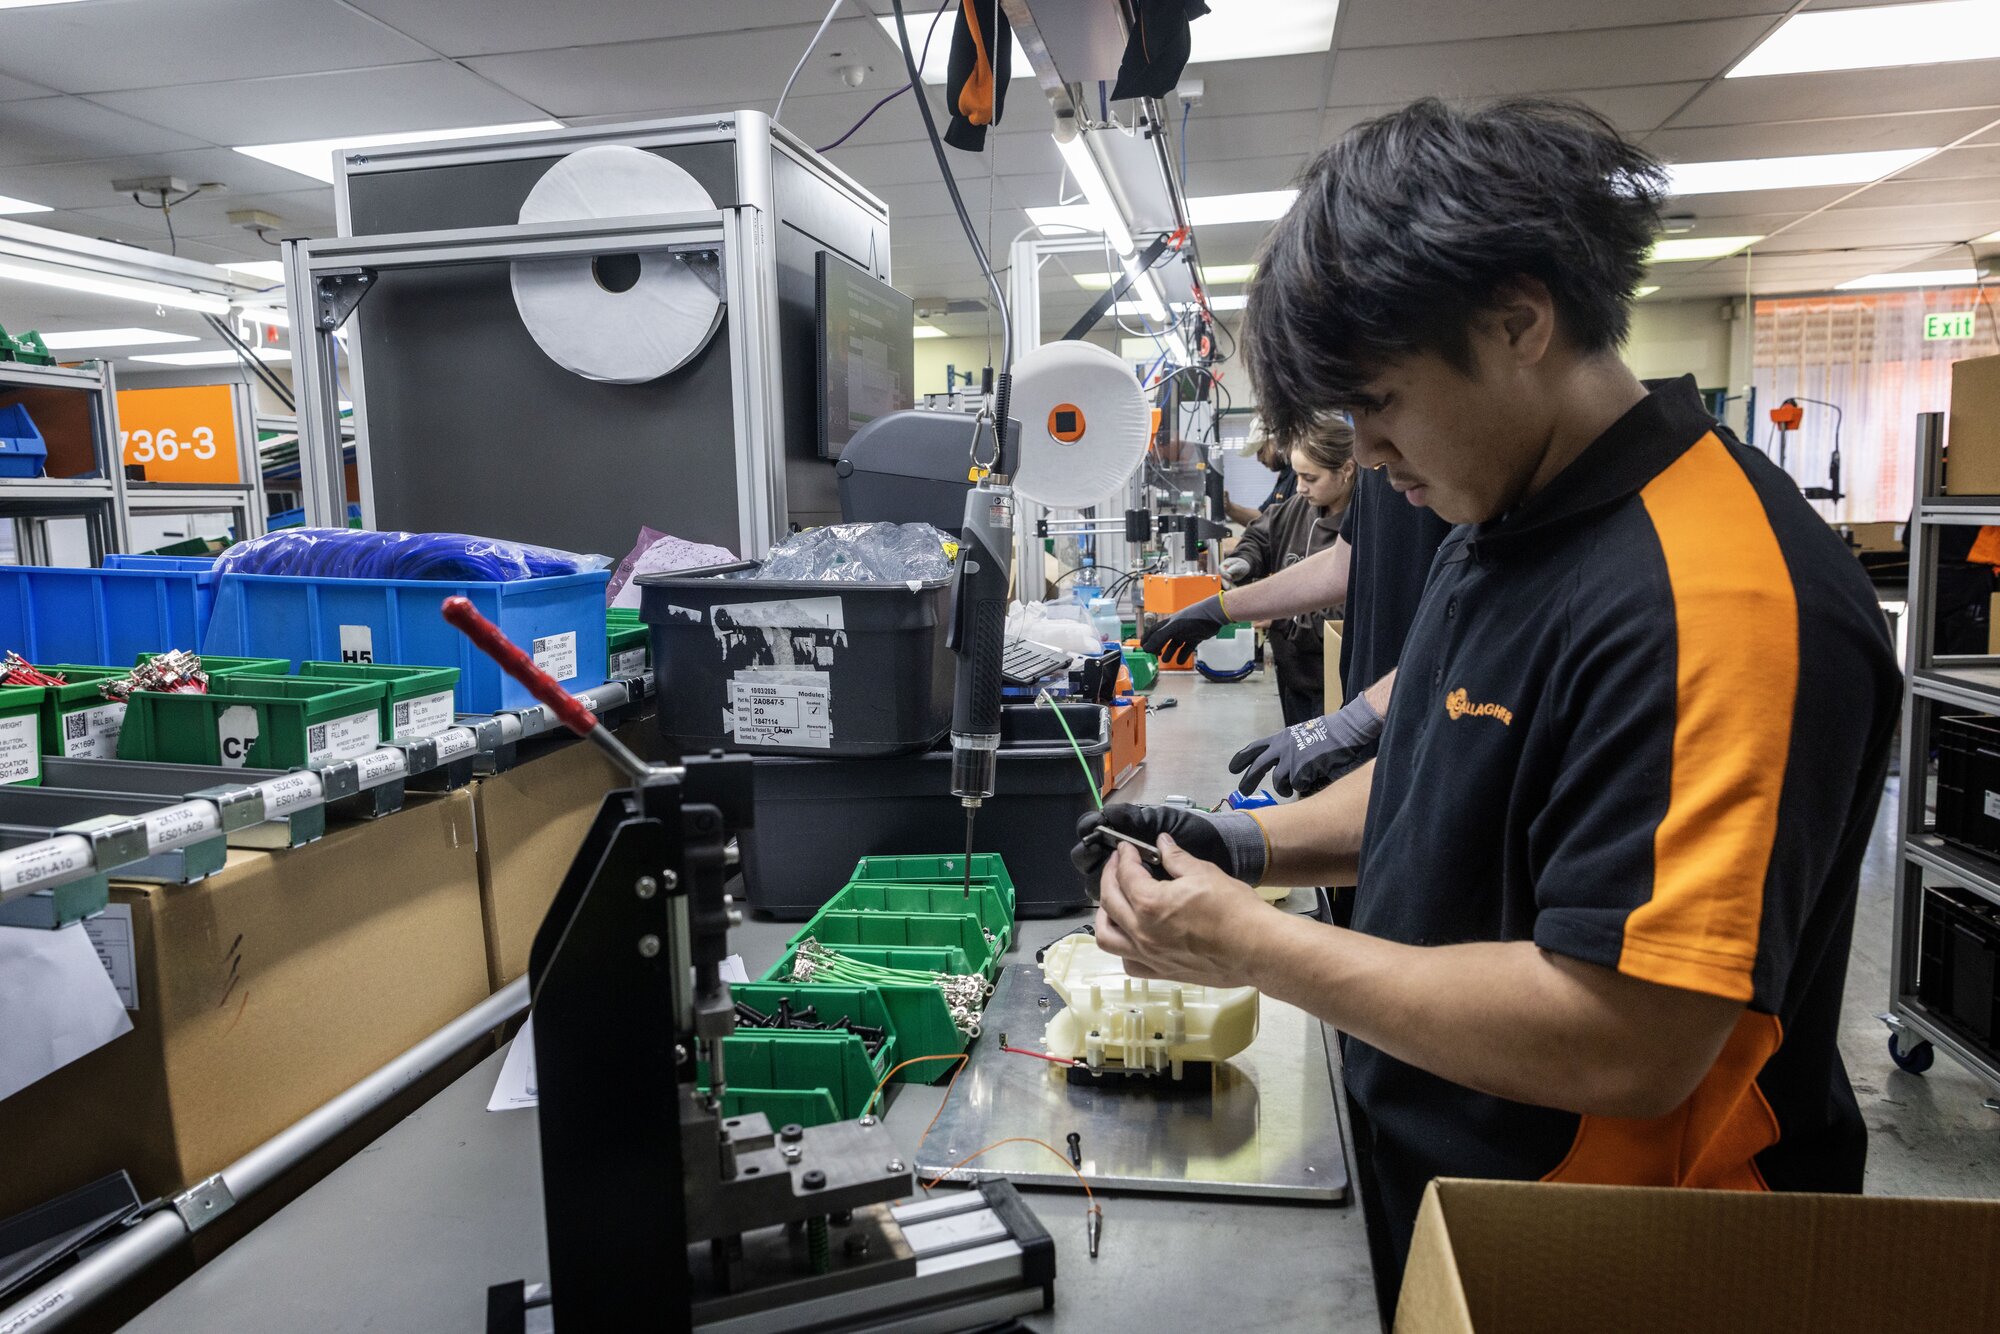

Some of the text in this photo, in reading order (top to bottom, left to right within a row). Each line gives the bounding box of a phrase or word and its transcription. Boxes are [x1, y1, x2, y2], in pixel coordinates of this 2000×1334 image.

[1928, 317, 1970, 337] Exit
[342, 650, 372, 663] H5
[753, 698, 784, 706] 2A0847-5
[352, 715, 368, 724] WEIGHT
[70, 739, 95, 750] 2K1699
[444, 740, 470, 755] ES01-A06
[366, 762, 396, 779] ES01-A07
[276, 788, 312, 807] ES01-A08
[159, 820, 203, 843] ES01-A09
[16, 858, 74, 883] ES01-A10
